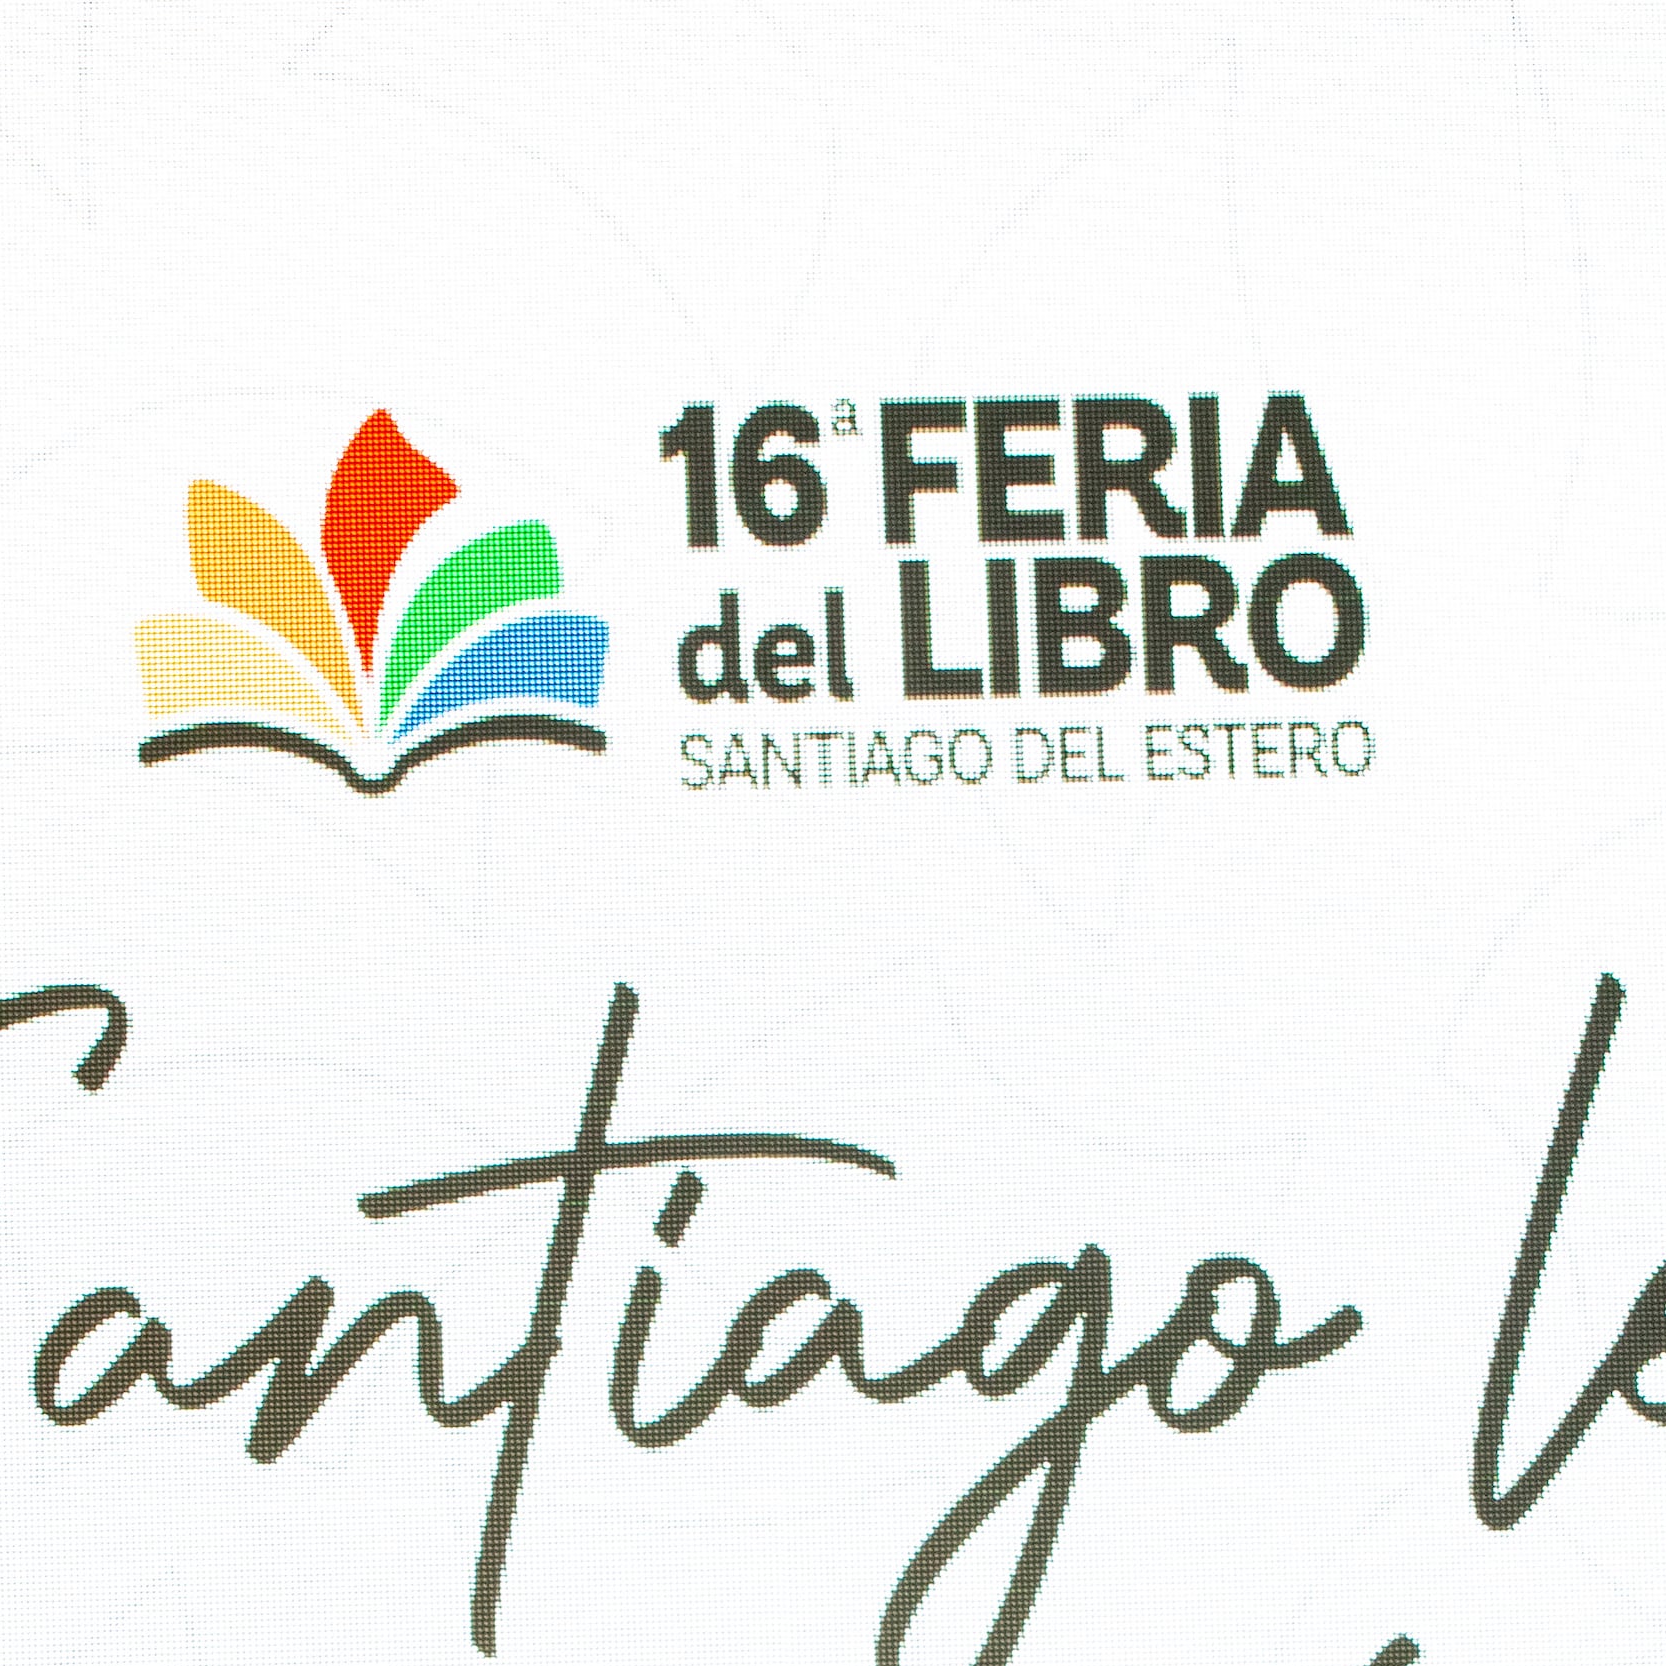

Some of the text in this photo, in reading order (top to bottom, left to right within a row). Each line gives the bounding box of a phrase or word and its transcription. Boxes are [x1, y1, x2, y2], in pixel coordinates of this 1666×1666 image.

[879, 393, 1353, 544] FERIA
[677, 552, 1367, 702] del LIBRO
[678, 718, 1376, 792] SANTIAGO DEL ESTERO
